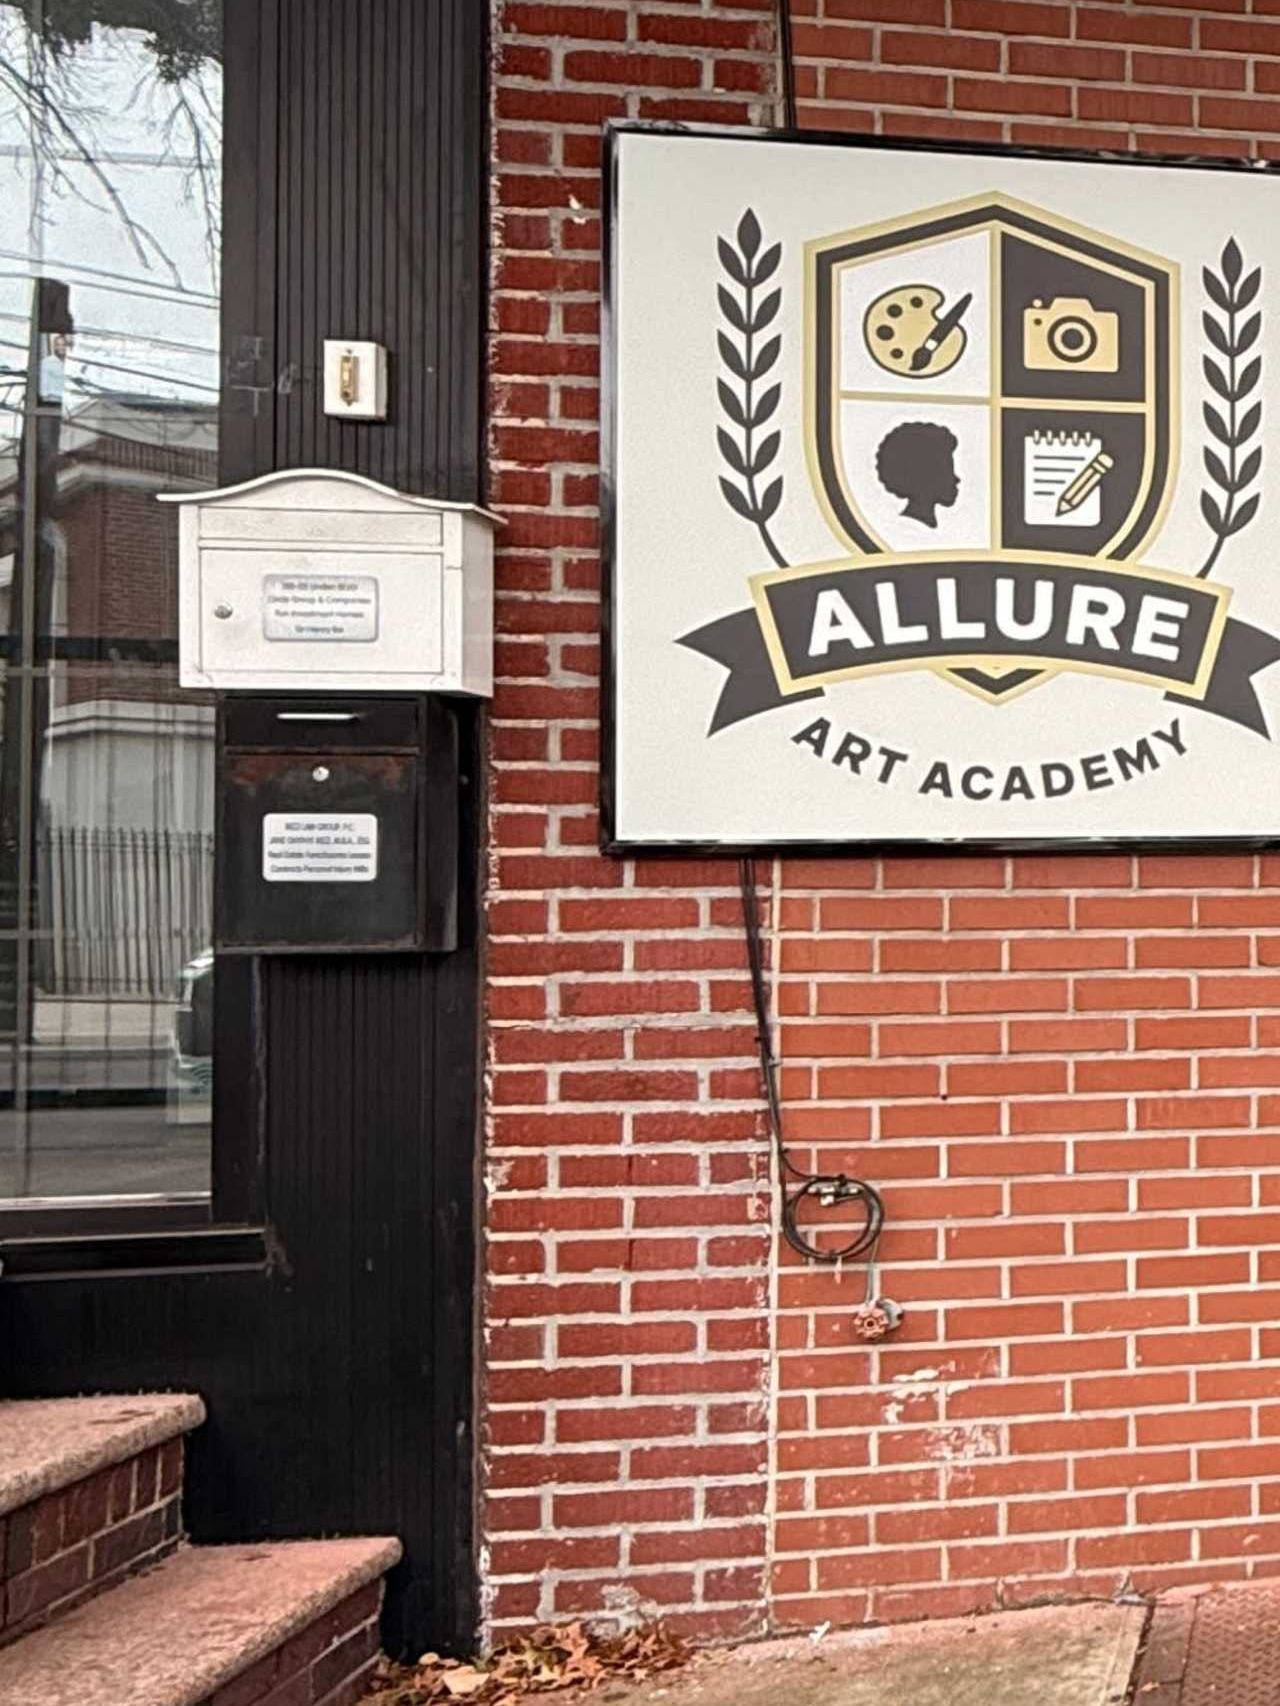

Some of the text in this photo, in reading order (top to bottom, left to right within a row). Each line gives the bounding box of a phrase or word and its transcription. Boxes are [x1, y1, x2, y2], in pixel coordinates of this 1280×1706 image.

[807, 577, 1190, 663] ALLURE
[790, 717, 1190, 802] ART ACADEMY
